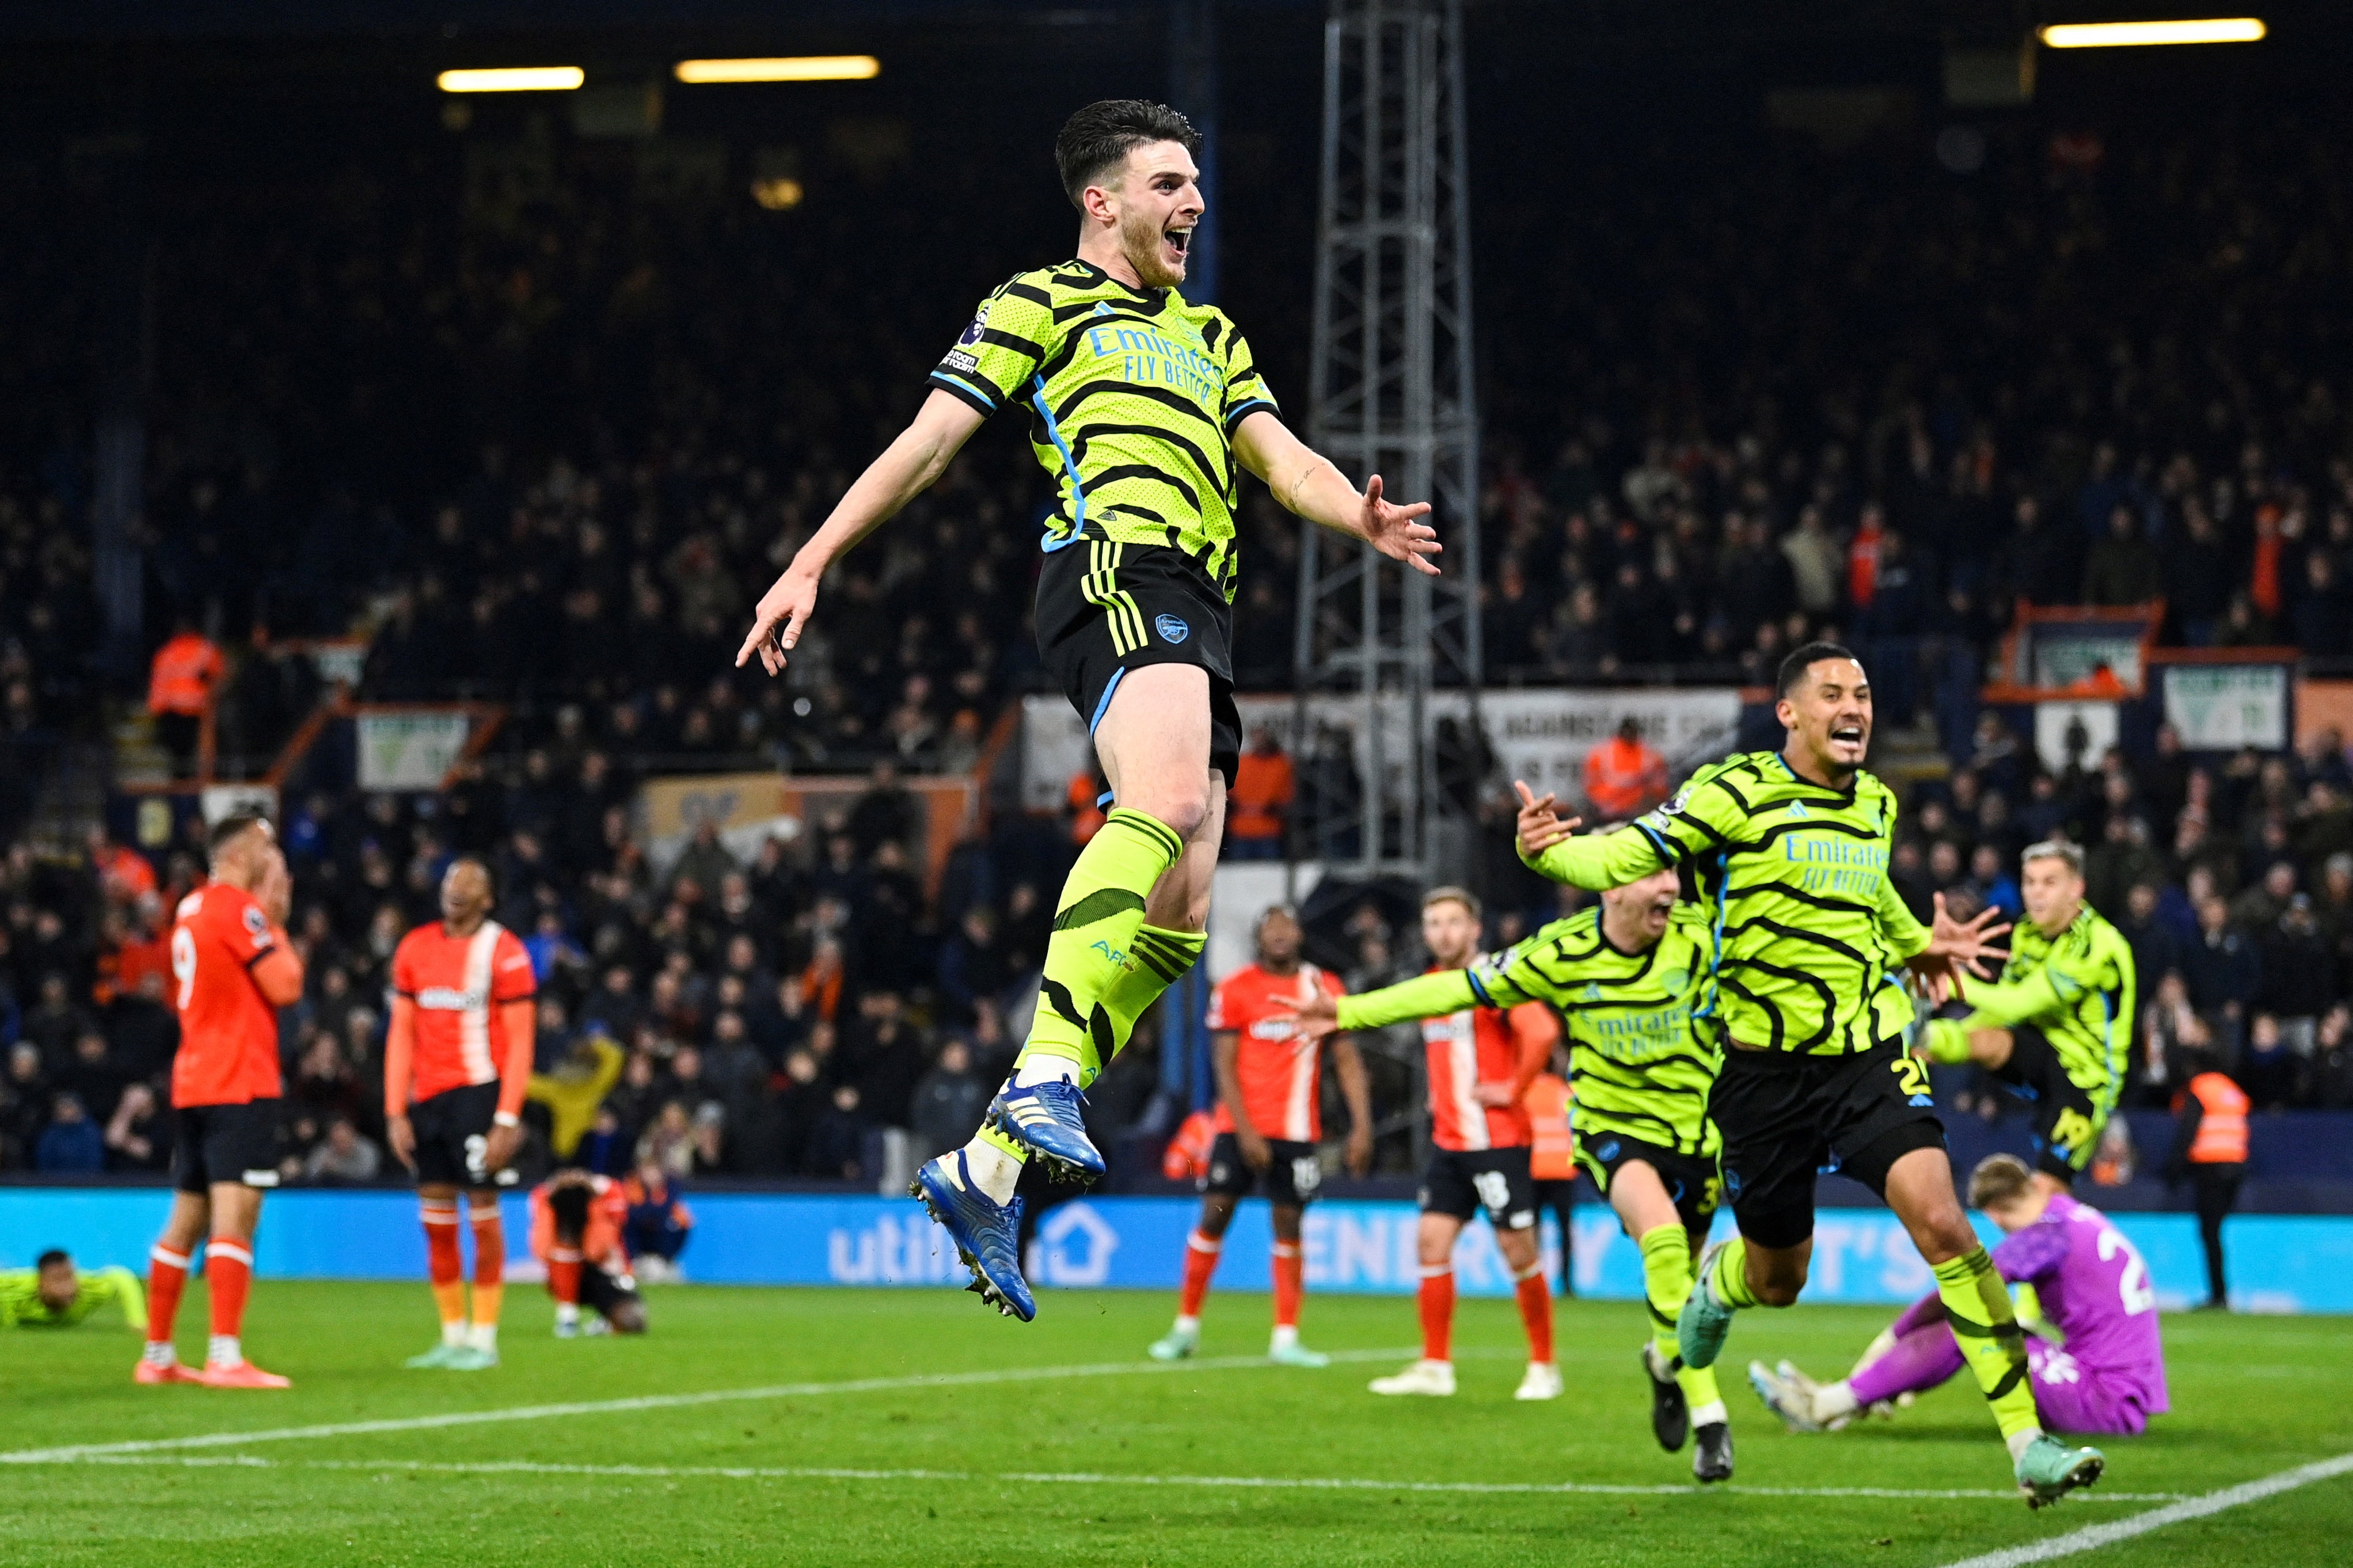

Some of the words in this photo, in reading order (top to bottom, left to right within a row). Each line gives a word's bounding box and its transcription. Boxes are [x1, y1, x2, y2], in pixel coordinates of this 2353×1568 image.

[953, 351, 975, 366] room
[1086, 328, 1223, 390] Emirates
[1125, 356, 1155, 381] FLY
[1164, 360, 1210, 409] BETTER
[1786, 834, 1890, 871] Emirate
[1090, 940, 1127, 966] AFC
[829, 1212, 1042, 1285] util
